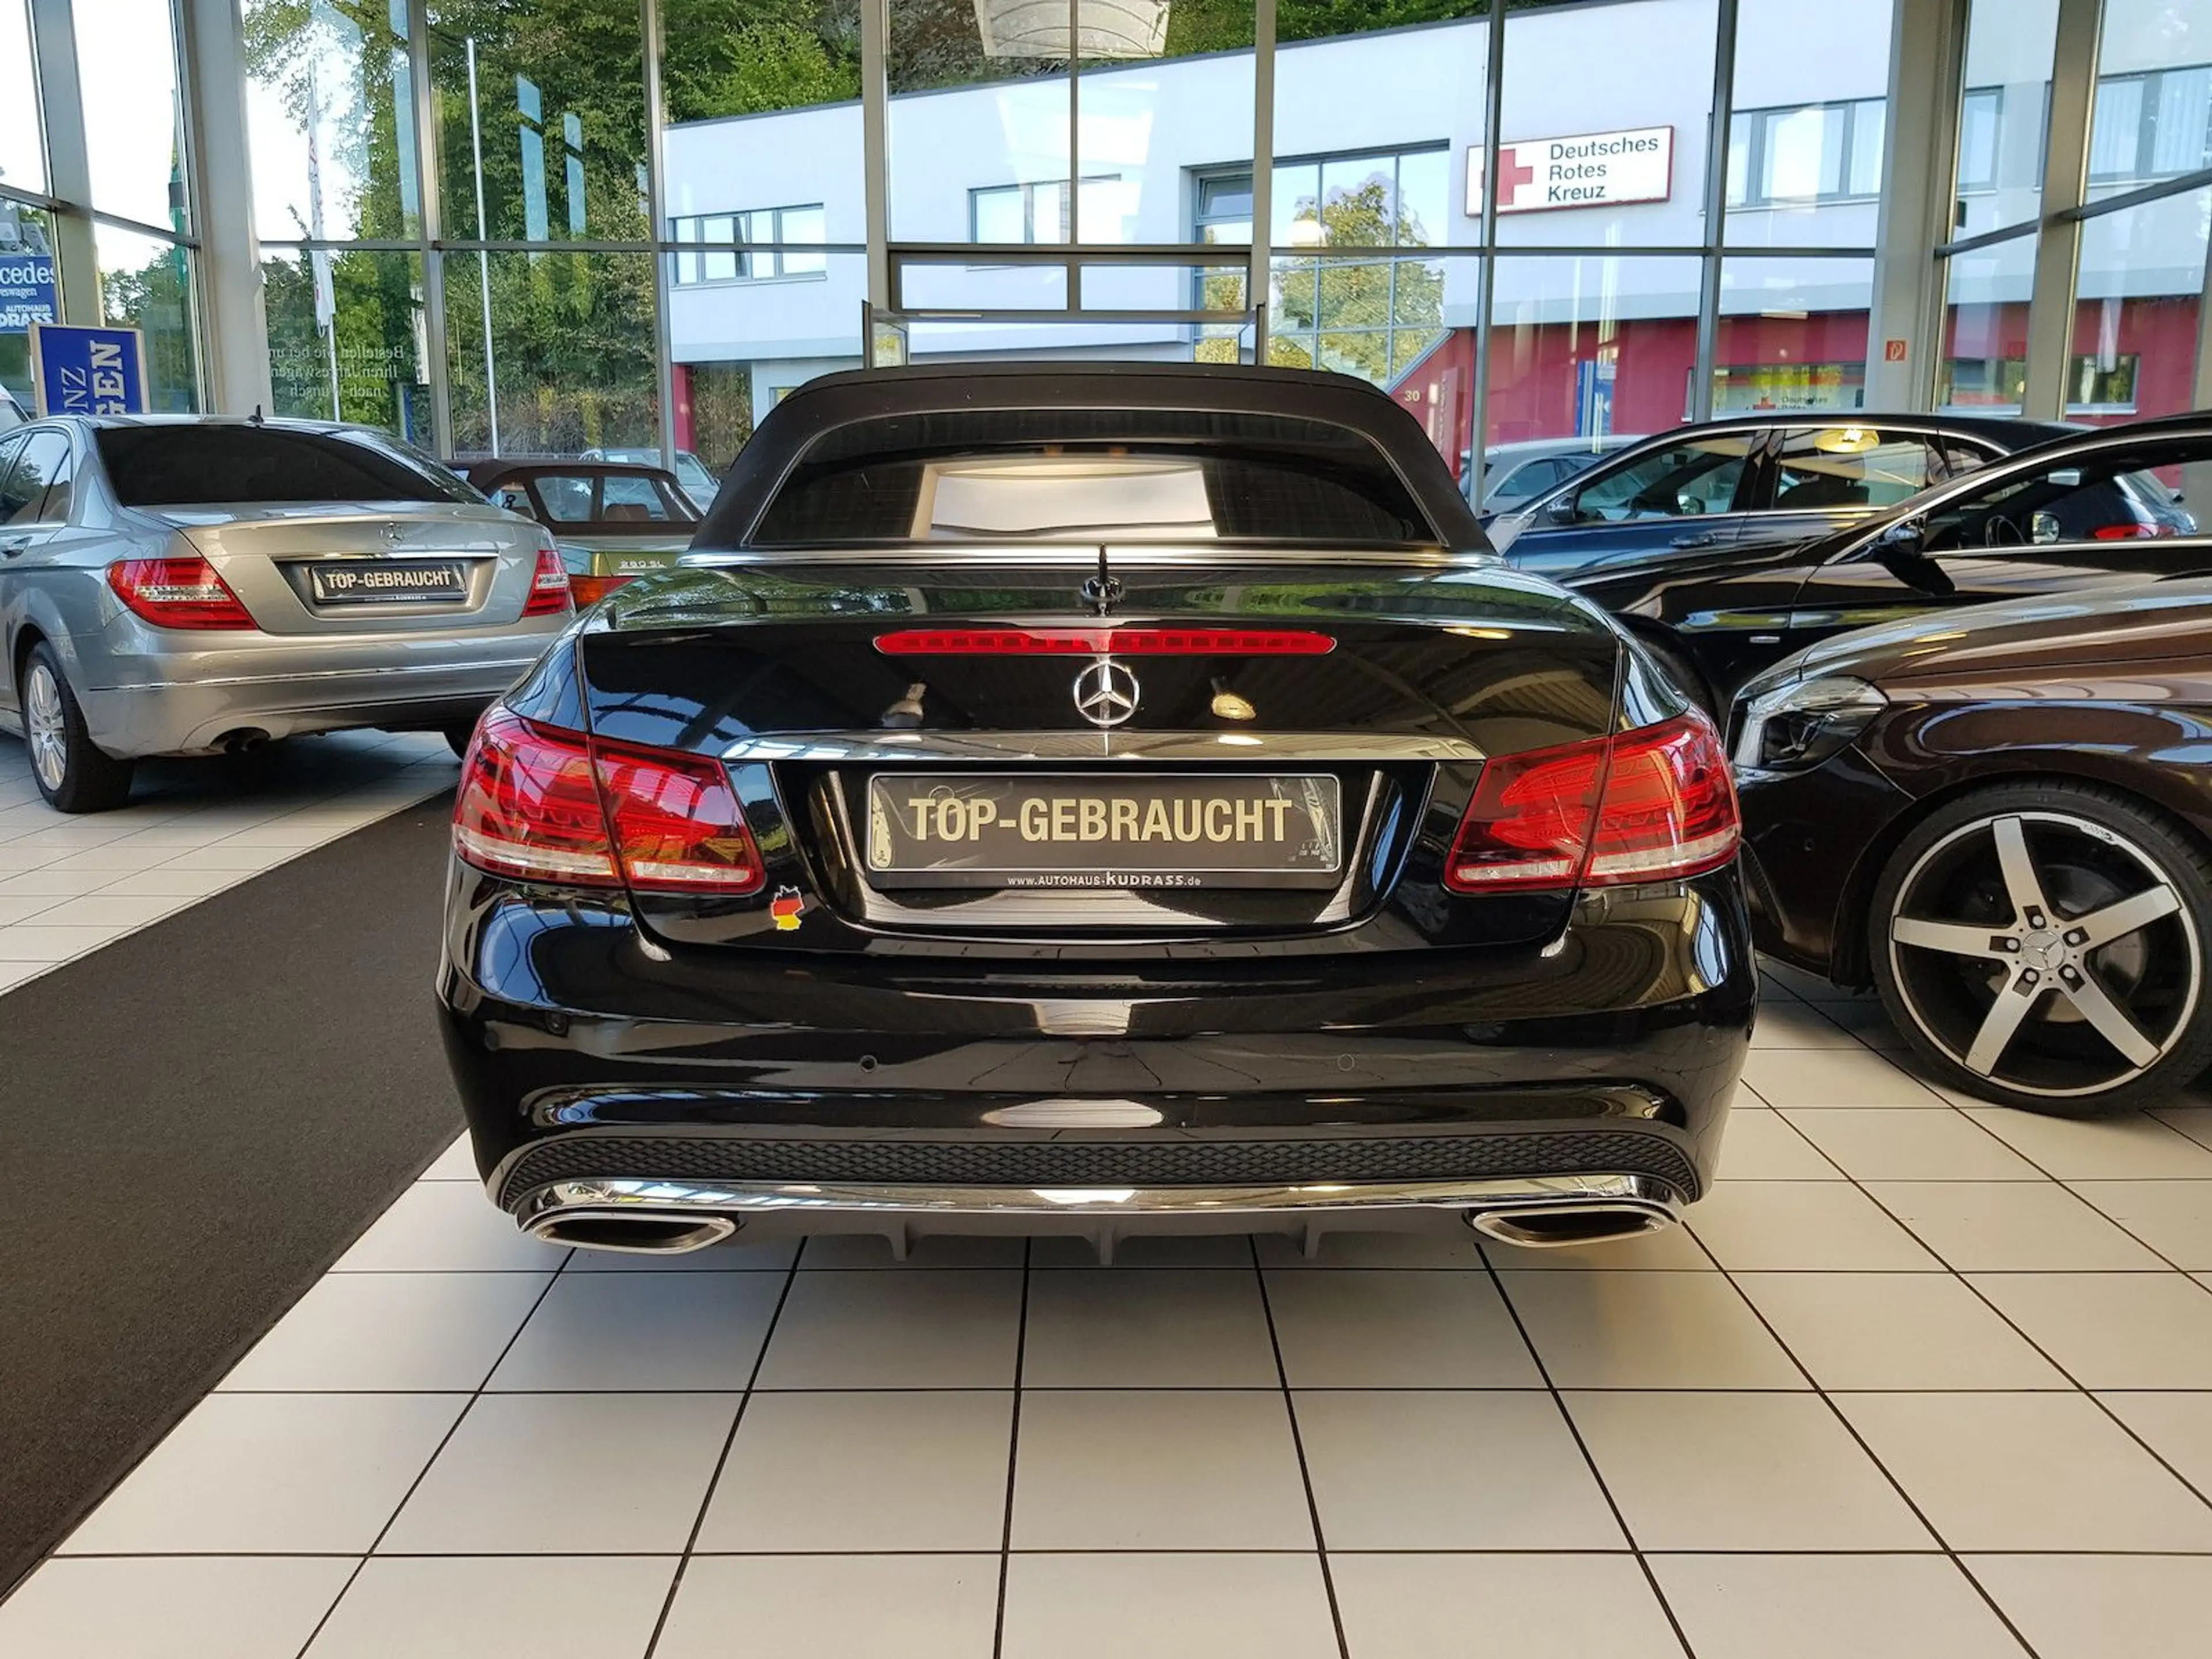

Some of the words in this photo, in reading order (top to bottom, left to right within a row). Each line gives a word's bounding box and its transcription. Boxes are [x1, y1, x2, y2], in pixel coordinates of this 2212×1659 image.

[1550, 137, 1659, 160] Deutsches
[1549, 163, 1607, 181] Rotes
[1548, 185, 1606, 202] Kreuz
[6, 304, 51, 313] AUTOHAUS
[60, 366, 90, 415] NZ
[1403, 390, 1421, 402] 30
[326, 571, 450, 589] TOP-GEBRAUCHT
[908, 798, 1292, 842] TOP-GEBRAUCHT
